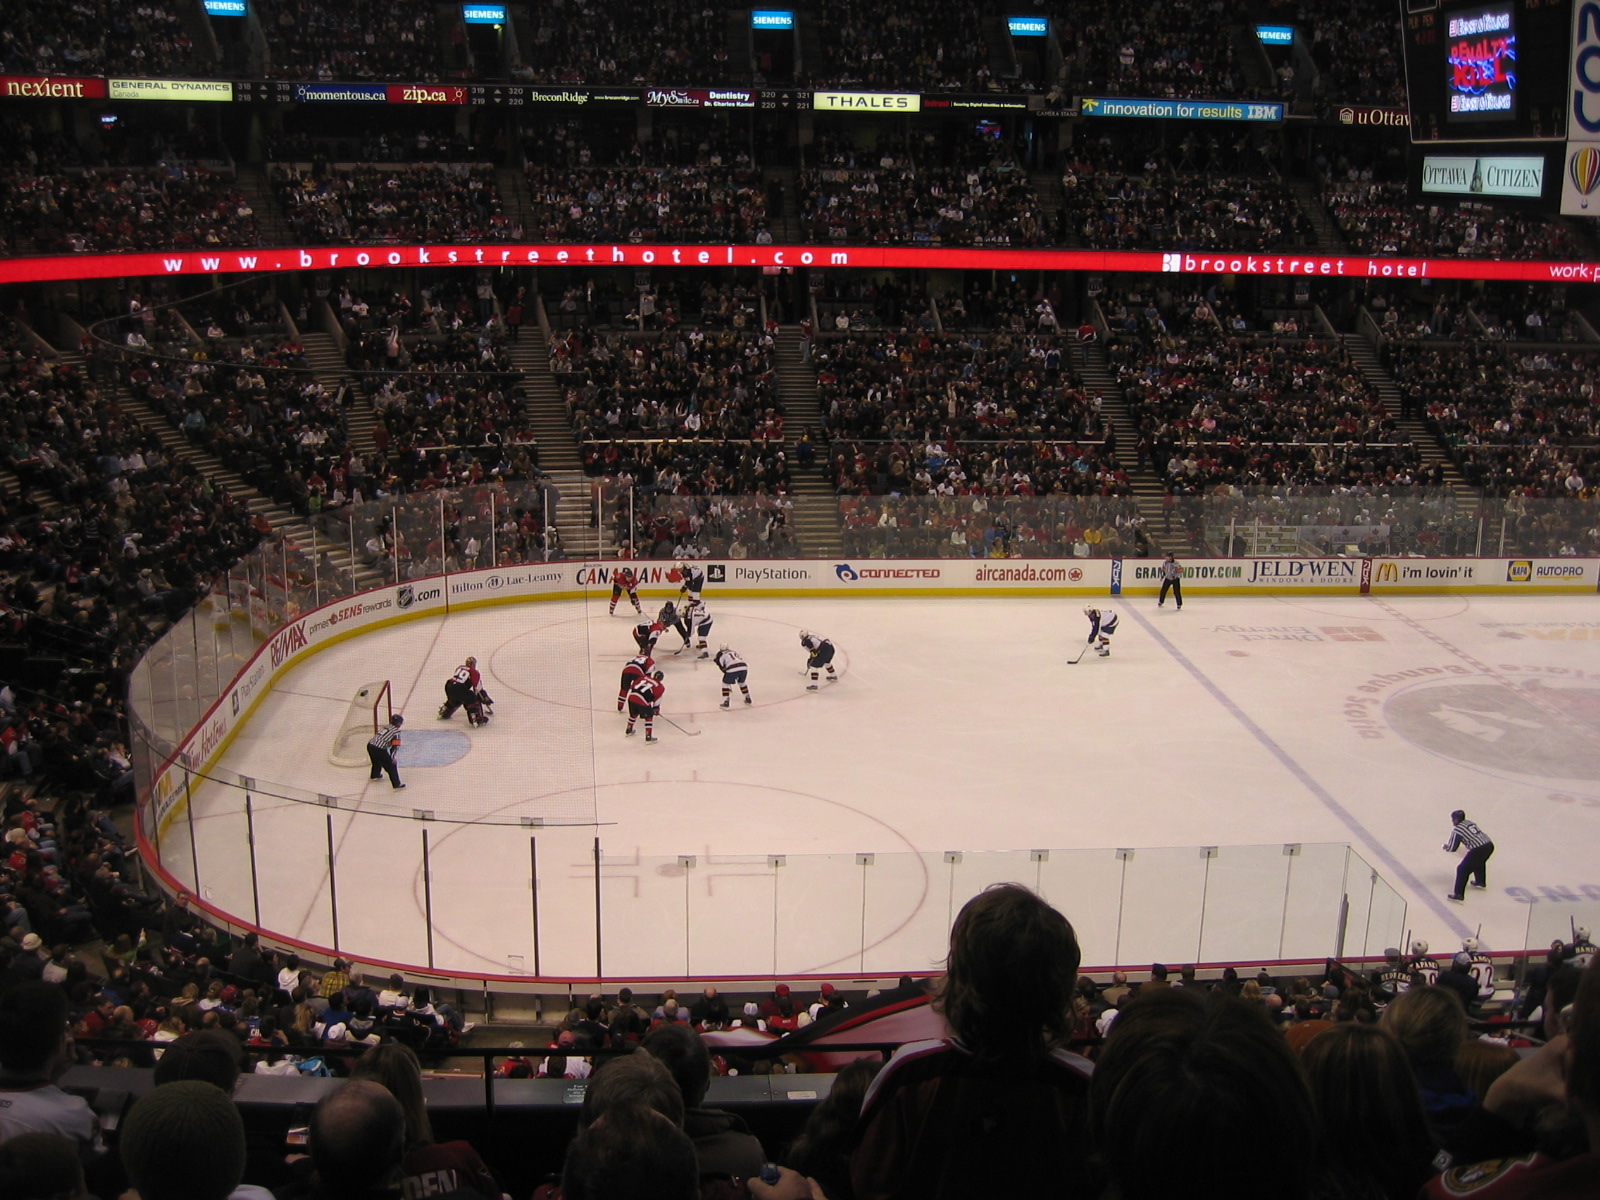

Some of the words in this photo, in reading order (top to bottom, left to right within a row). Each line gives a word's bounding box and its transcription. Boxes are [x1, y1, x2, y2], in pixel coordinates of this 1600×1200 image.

[205, 1, 245, 12] SIEMENS
[464, 9, 504, 20] SIEMENS
[753, 15, 792, 26] SIEMENS
[1008, 22, 1046, 32] SIEMENS
[7, 78, 84, 98] nexient
[112, 81, 168, 90] GENERAL
[171, 83, 230, 92] DYNAMICS
[112, 90, 140, 98] Canada
[306, 91, 387, 101] momentous.ca
[403, 86, 447, 104] zip.ca
[709, 91, 750, 101] Dentistry
[827, 96, 908, 108] THALES
[1103, 102, 1170, 116] innovation
[1176, 104, 1193, 117] for
[1198, 104, 1242, 119] results
[1247, 105, 1278, 119] IBM
[1423, 165, 1467, 186] OTTAWA
[1486, 165, 1541, 188] CITIZEN
[163, 246, 849, 273] www.brookstreethotel.com
[1185, 255, 1345, 275] brookstreet
[1367, 261, 1428, 277] hotel
[859, 569, 941, 579] CONNECTED
[976, 565, 1066, 582] aircanada.com
[1403, 568, 1421, 578] i'm
[1425, 566, 1461, 578] lovin'
[1464, 567, 1473, 578] it
[1536, 566, 1584, 576] AUTOPRO
[506, 572, 562, 585] Lac-Leamy
[452, 581, 483, 594] Hilton
[414, 588, 440, 602] .com
[338, 604, 363, 622] SENS
[362, 599, 392, 614] rewards
[270, 620, 308, 670] RE/MAX
[1356, 665, 1473, 692] Banque
